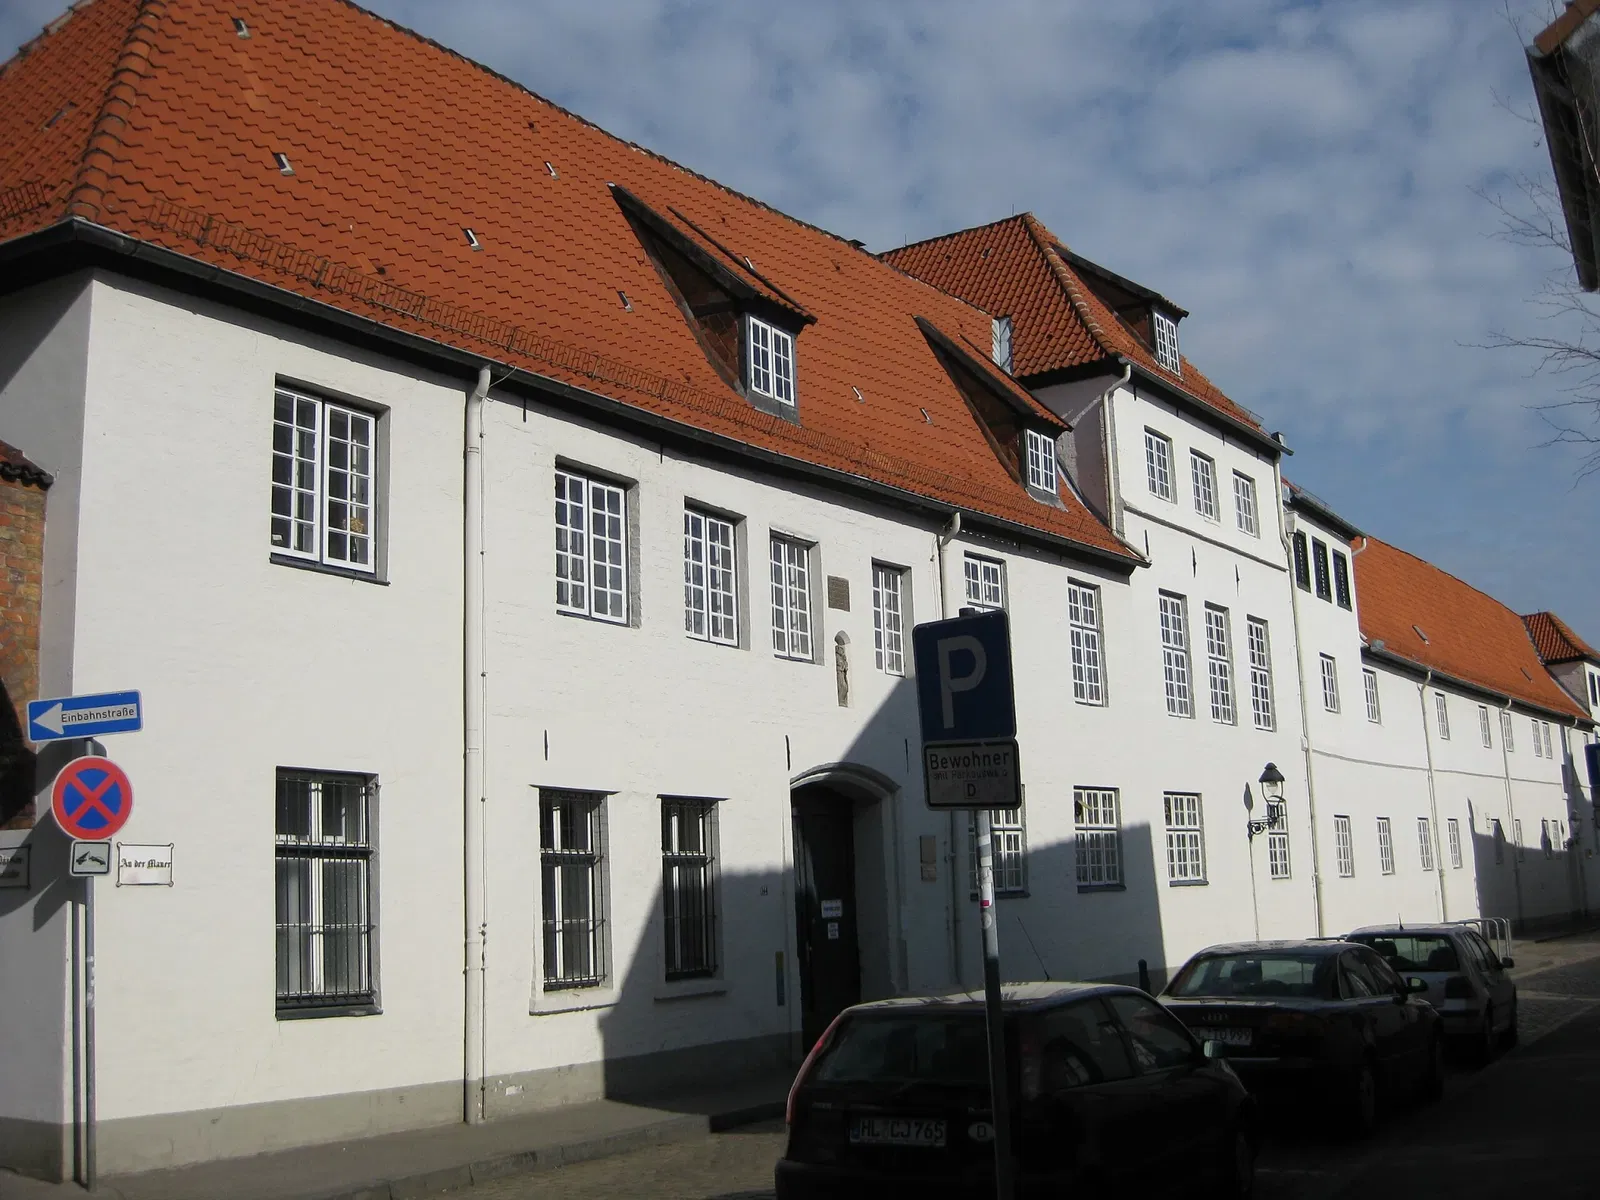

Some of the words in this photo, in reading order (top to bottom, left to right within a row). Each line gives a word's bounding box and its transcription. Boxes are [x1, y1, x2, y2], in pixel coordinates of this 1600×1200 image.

[937, 635, 987, 729] P
[61, 708, 135, 723] Einbahnstraße
[929, 750, 1010, 770] Bewohner
[967, 783, 976, 797] D
[120, 858, 132, 868] An
[134, 860, 145, 868] der
[147, 859, 171, 869] Mauer
[861, 1119, 880, 1138] HL
[913, 1121, 945, 1140] 765
[977, 1124, 987, 1138] D
